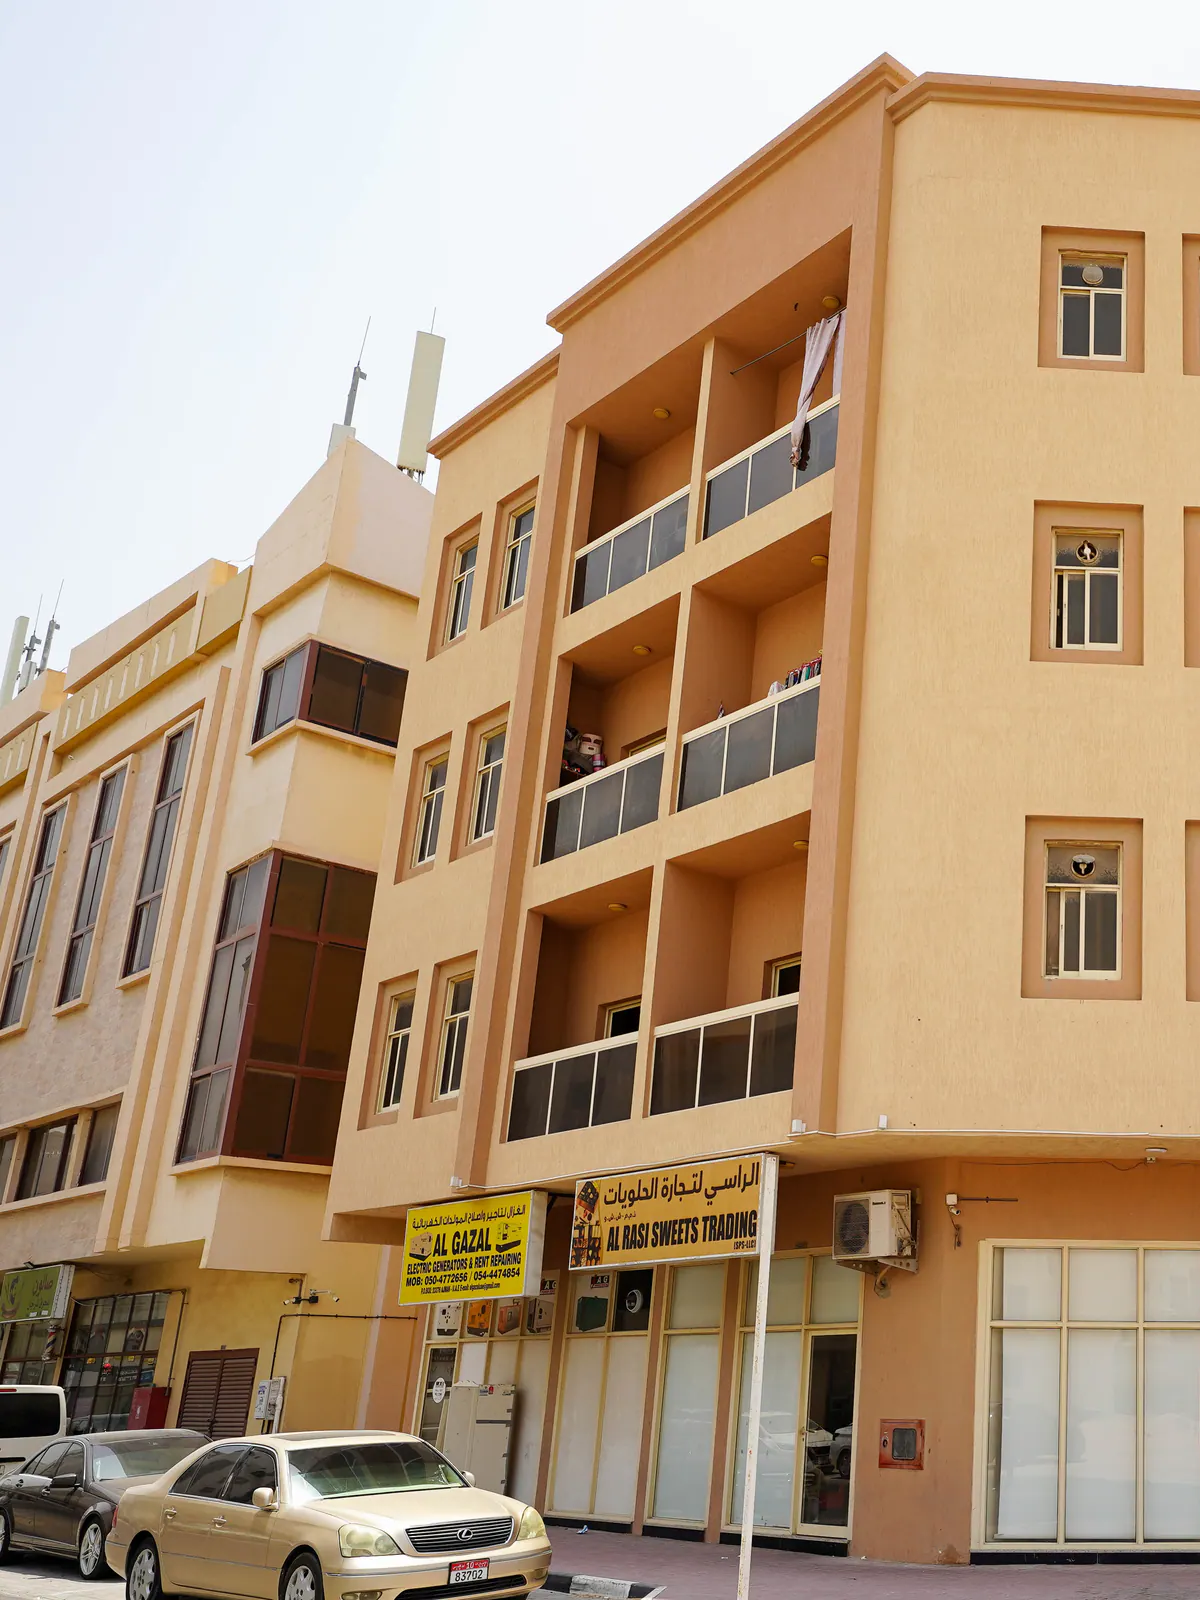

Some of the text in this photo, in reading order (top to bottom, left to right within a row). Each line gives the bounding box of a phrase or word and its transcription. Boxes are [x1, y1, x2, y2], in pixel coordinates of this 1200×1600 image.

[603, 1161, 760, 1209] الراسي لتجارة الحلويات
[606, 1209, 758, 1252] AL RASI SWEETS TRADING
[433, 1227, 492, 1258] AL GAZAL
[406, 1262, 432, 1275] ELECTRIC
[432, 1258, 468, 1273] GENERATORS
[468, 1257, 473, 1269] &
[474, 1255, 490, 1268] RENT
[406, 1276, 423, 1287] MOB:
[465, 1561, 475, 1569] 10
[455, 1569, 484, 1582] 83702
